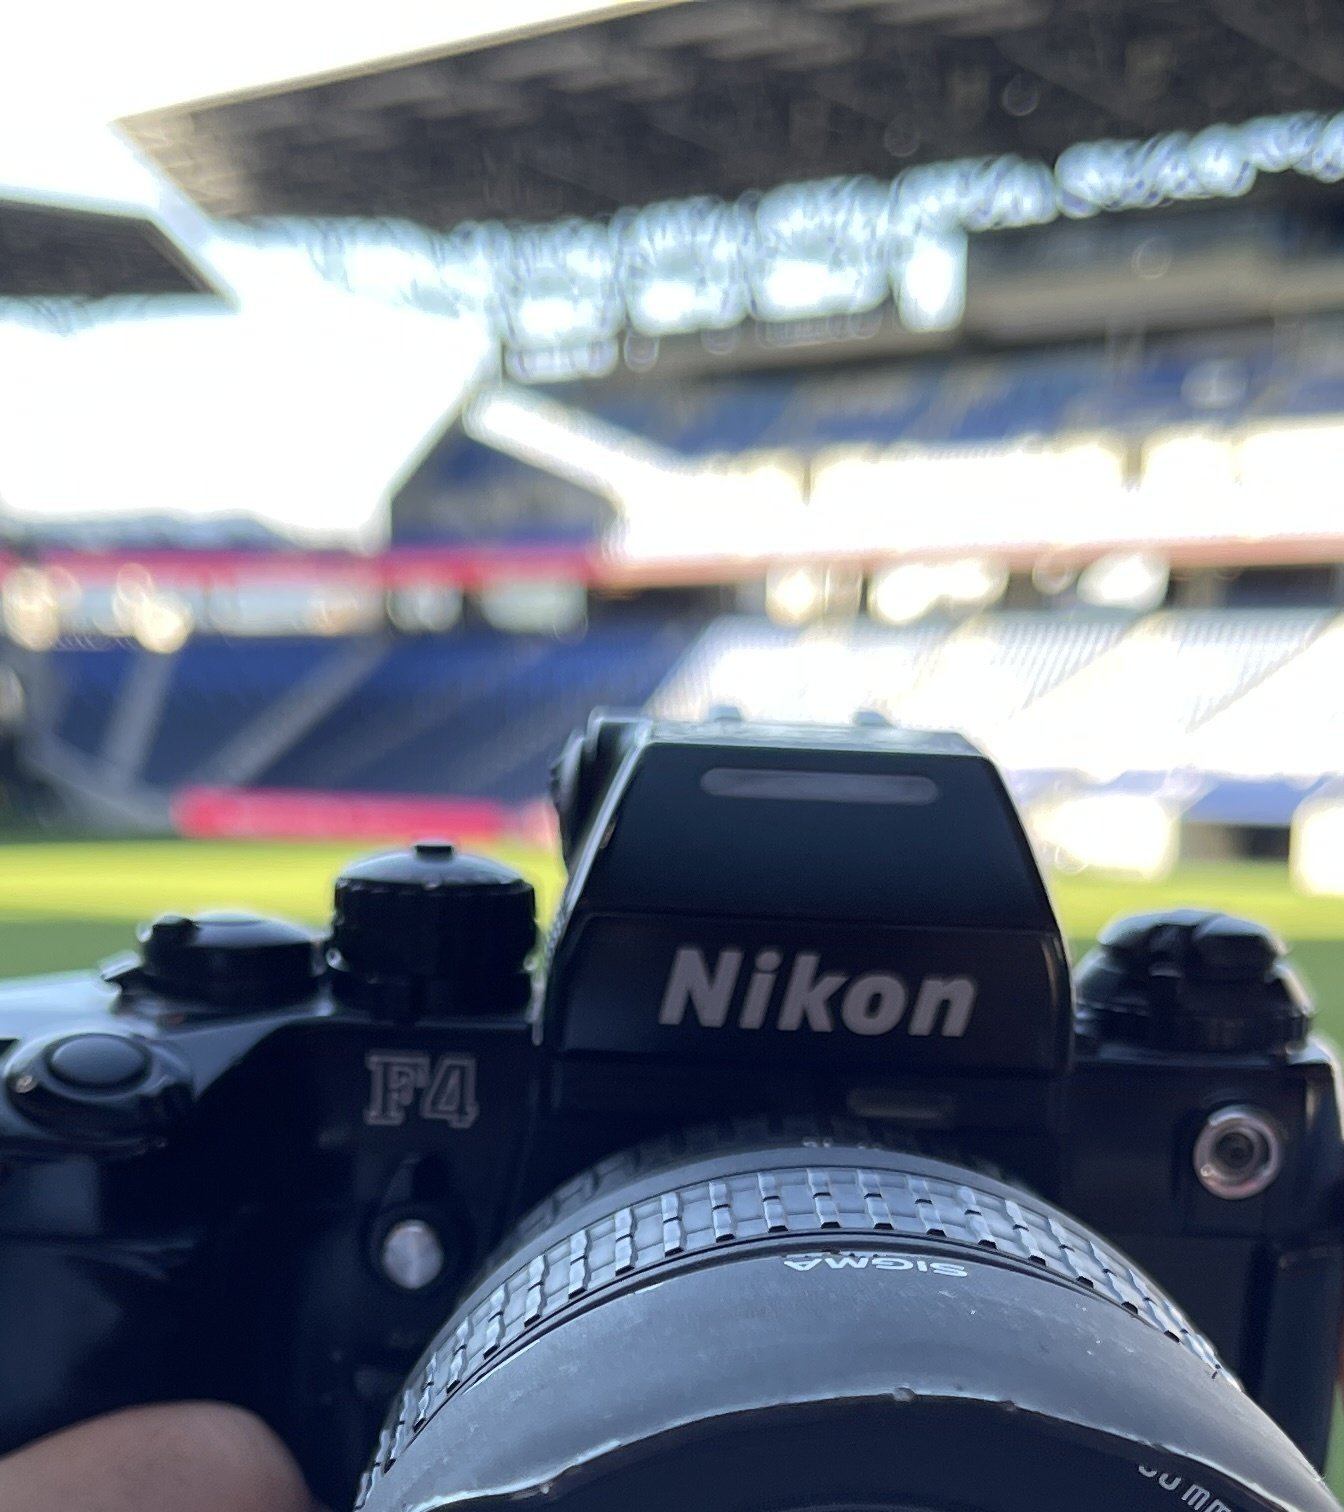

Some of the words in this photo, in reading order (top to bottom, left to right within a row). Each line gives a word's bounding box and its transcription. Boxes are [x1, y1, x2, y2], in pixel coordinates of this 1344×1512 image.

[659, 947, 977, 1037] Nikon
[364, 1052, 478, 1129] F4
[783, 1256, 969, 1277] SIGMA
